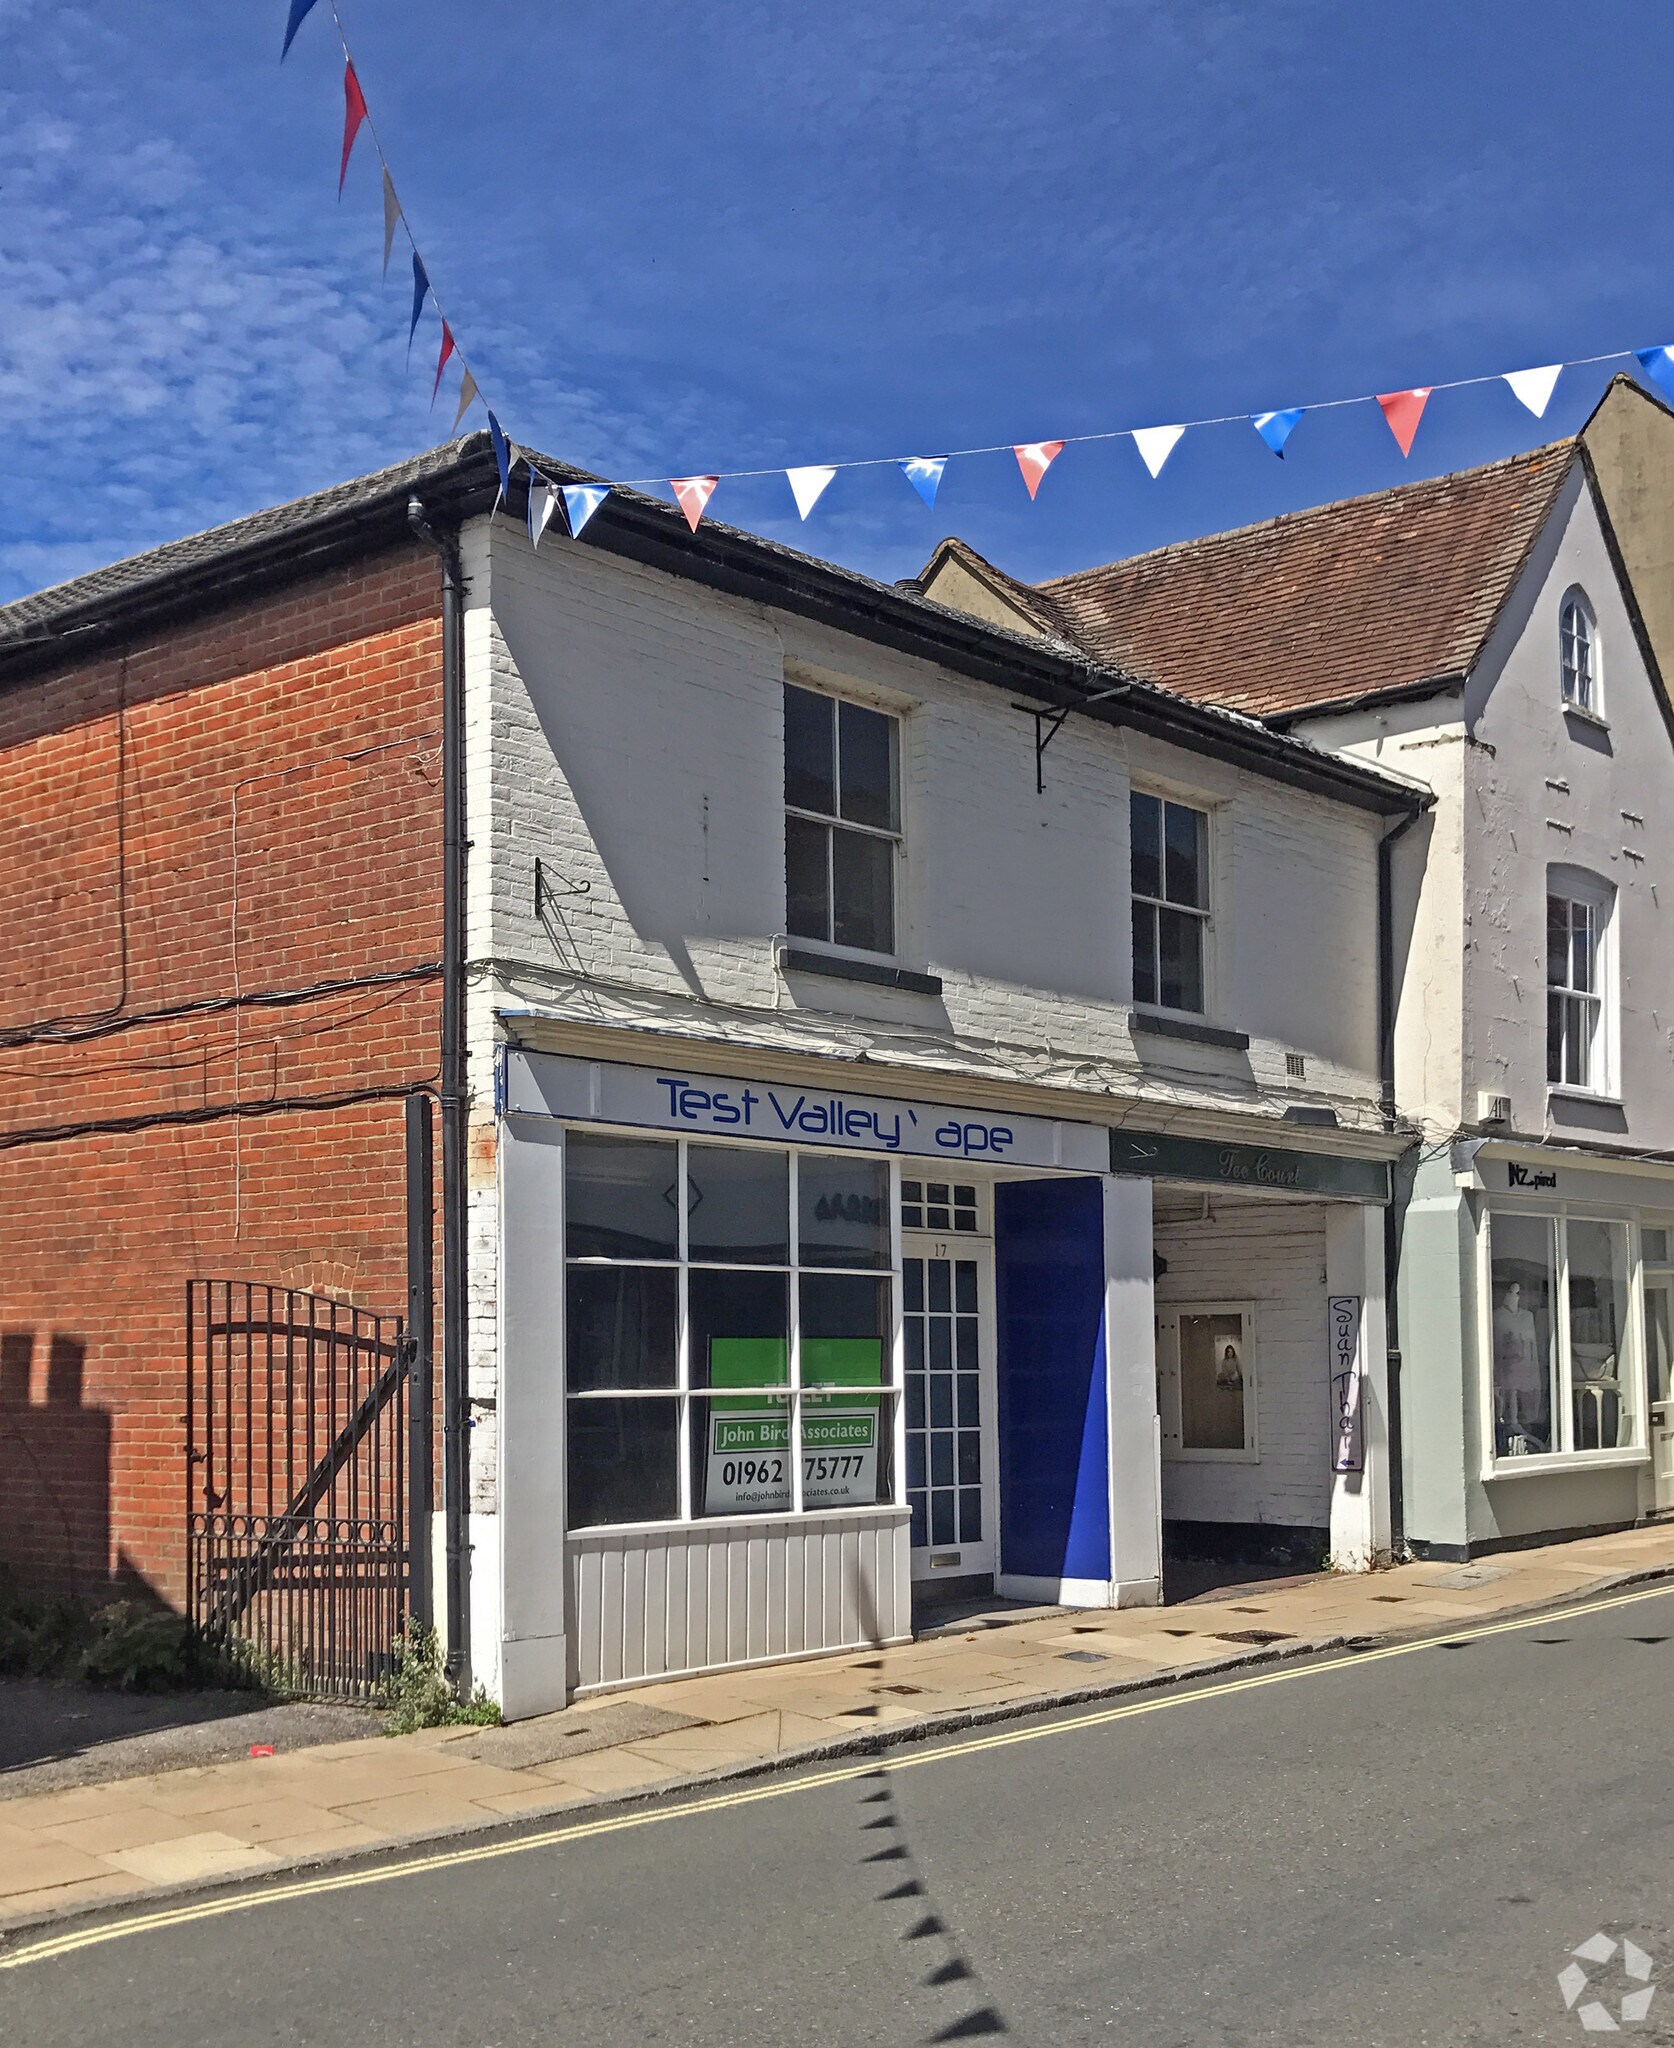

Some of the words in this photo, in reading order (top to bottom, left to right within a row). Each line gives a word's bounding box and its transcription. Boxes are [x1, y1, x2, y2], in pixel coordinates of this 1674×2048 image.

[656, 1077, 759, 1125] Test
[768, 1091, 900, 1148] Valley
[1253, 1152, 1300, 1186] Court
[935, 1243, 947, 1257] 17
[1332, 1299, 1353, 1366] Suan
[1332, 1370, 1357, 1449] Thai
[721, 1425, 755, 1448] John
[722, 1459, 783, 1486] 01962
[801, 1455, 865, 1481] 75777
